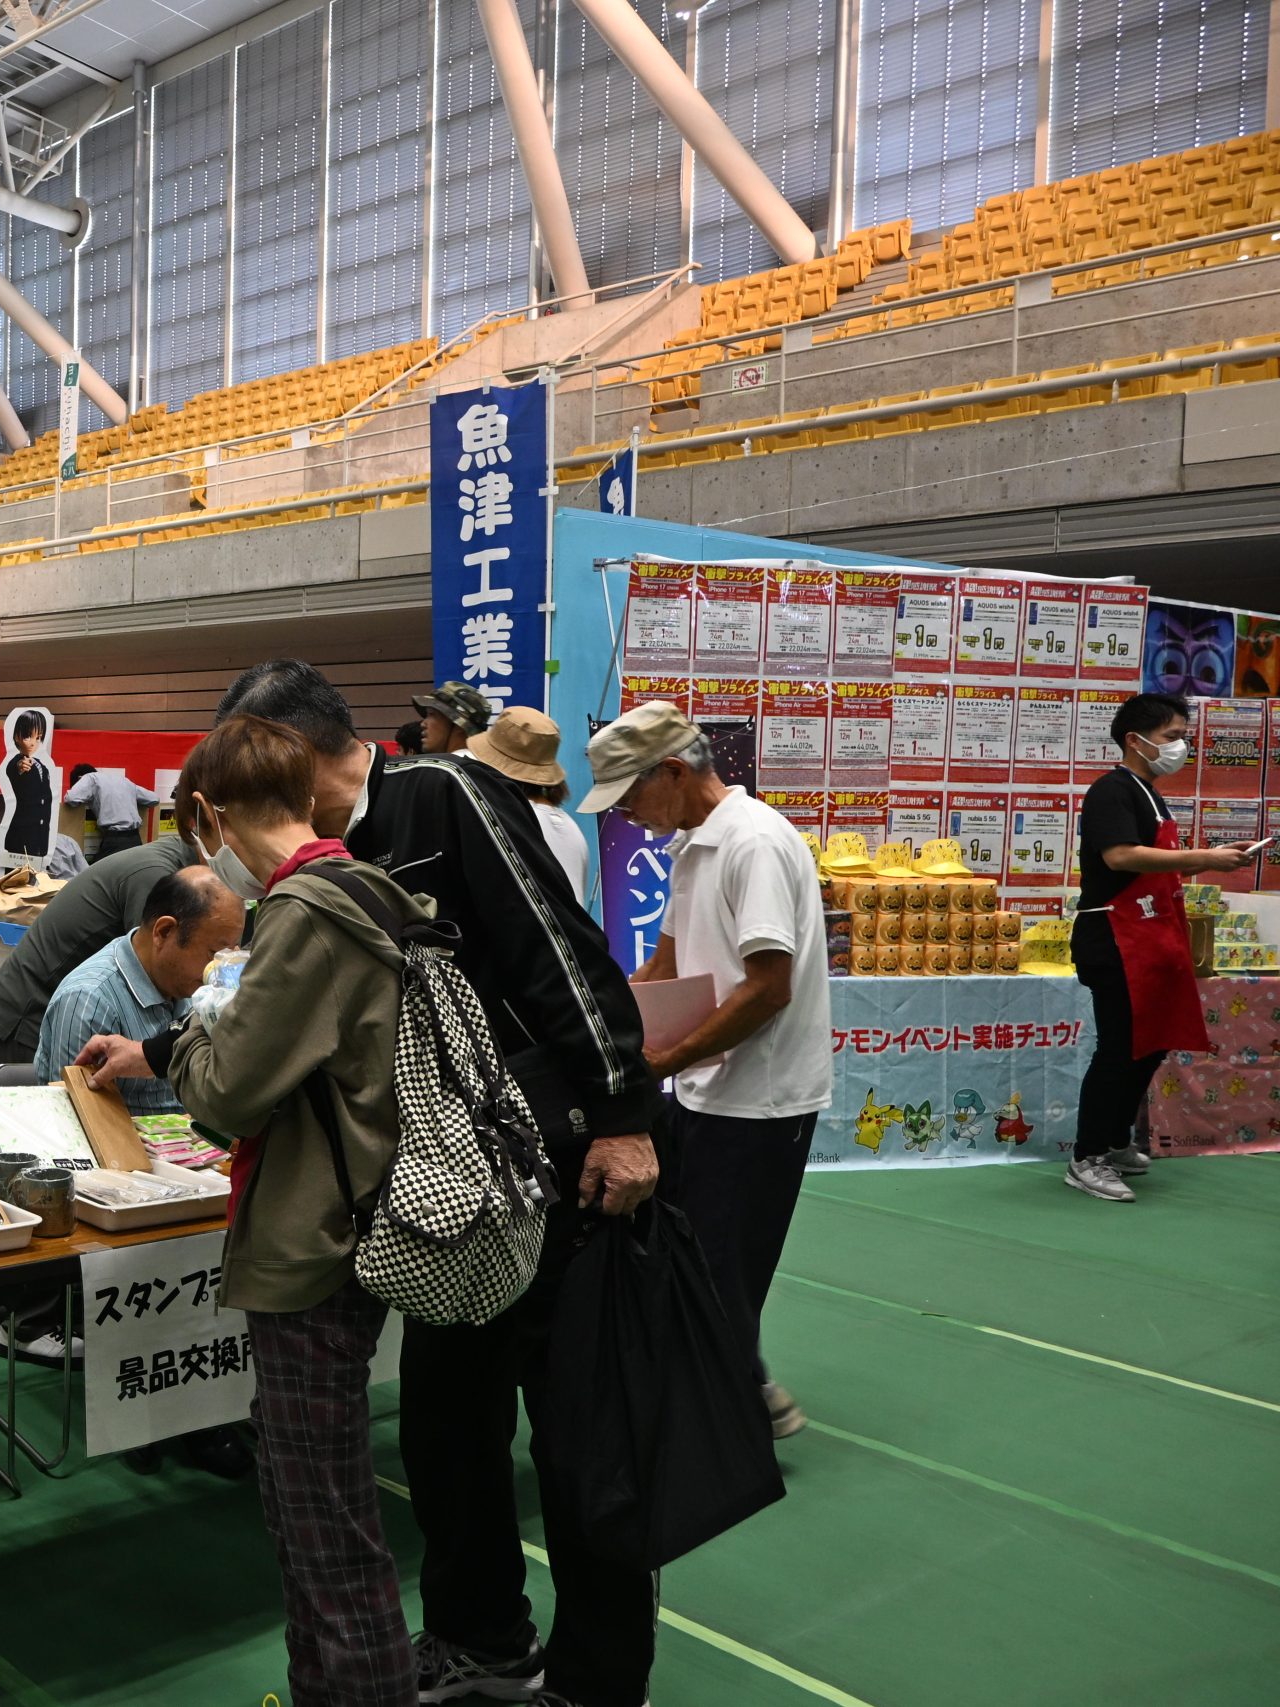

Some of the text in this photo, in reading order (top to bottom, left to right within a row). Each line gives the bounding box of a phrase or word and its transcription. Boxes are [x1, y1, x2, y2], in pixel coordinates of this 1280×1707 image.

[894, 684, 930, 696] 撃プライス
[1173, 1134, 1218, 1147] SoftBank
[807, 1152, 841, 1164] ftBank
